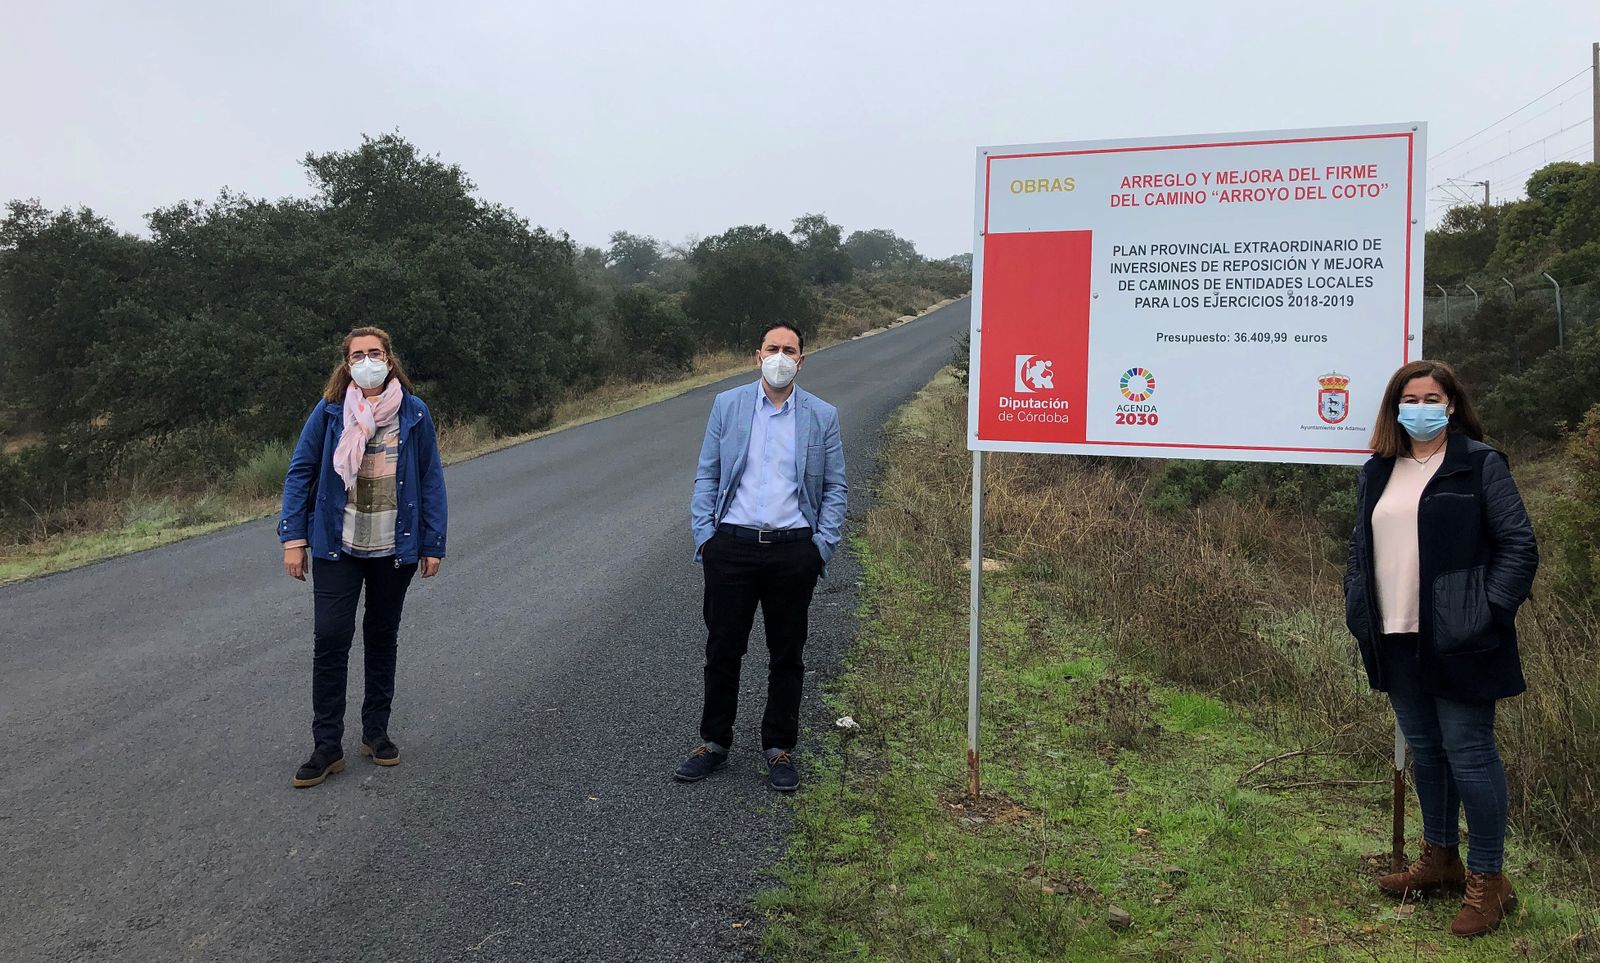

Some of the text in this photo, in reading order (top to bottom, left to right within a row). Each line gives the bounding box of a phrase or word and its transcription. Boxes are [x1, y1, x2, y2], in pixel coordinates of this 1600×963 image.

[1120, 164, 1377, 189] ARREGLO Y MEJORA DEL FIRME
[1010, 177, 1075, 194] OBRAS
[1110, 183, 1388, 208] DEL CAMINO “ARROYO DEL COTO”
[1113, 239, 1382, 256] PLAN PROVINCIAL EXTRAORDINARIO DE
[1111, 256, 1384, 274] INVERSIONES DE REPOSICIÓN Y MEJORA
[1119, 276, 1373, 291] DE CAMINOS DE ENTIDADES LOCALES
[1135, 294, 1354, 309] PARA LOS EJERCICIOS 2018-2019
[1157, 333, 1229, 344] Presupuesto:
[1234, 332, 1287, 344] 36.409,99
[999, 397, 1069, 410] Diputación
[1116, 404, 1158, 413] AGENDA
[998, 411, 1069, 423] de Córdoba
[1115, 413, 1159, 426] 2030
